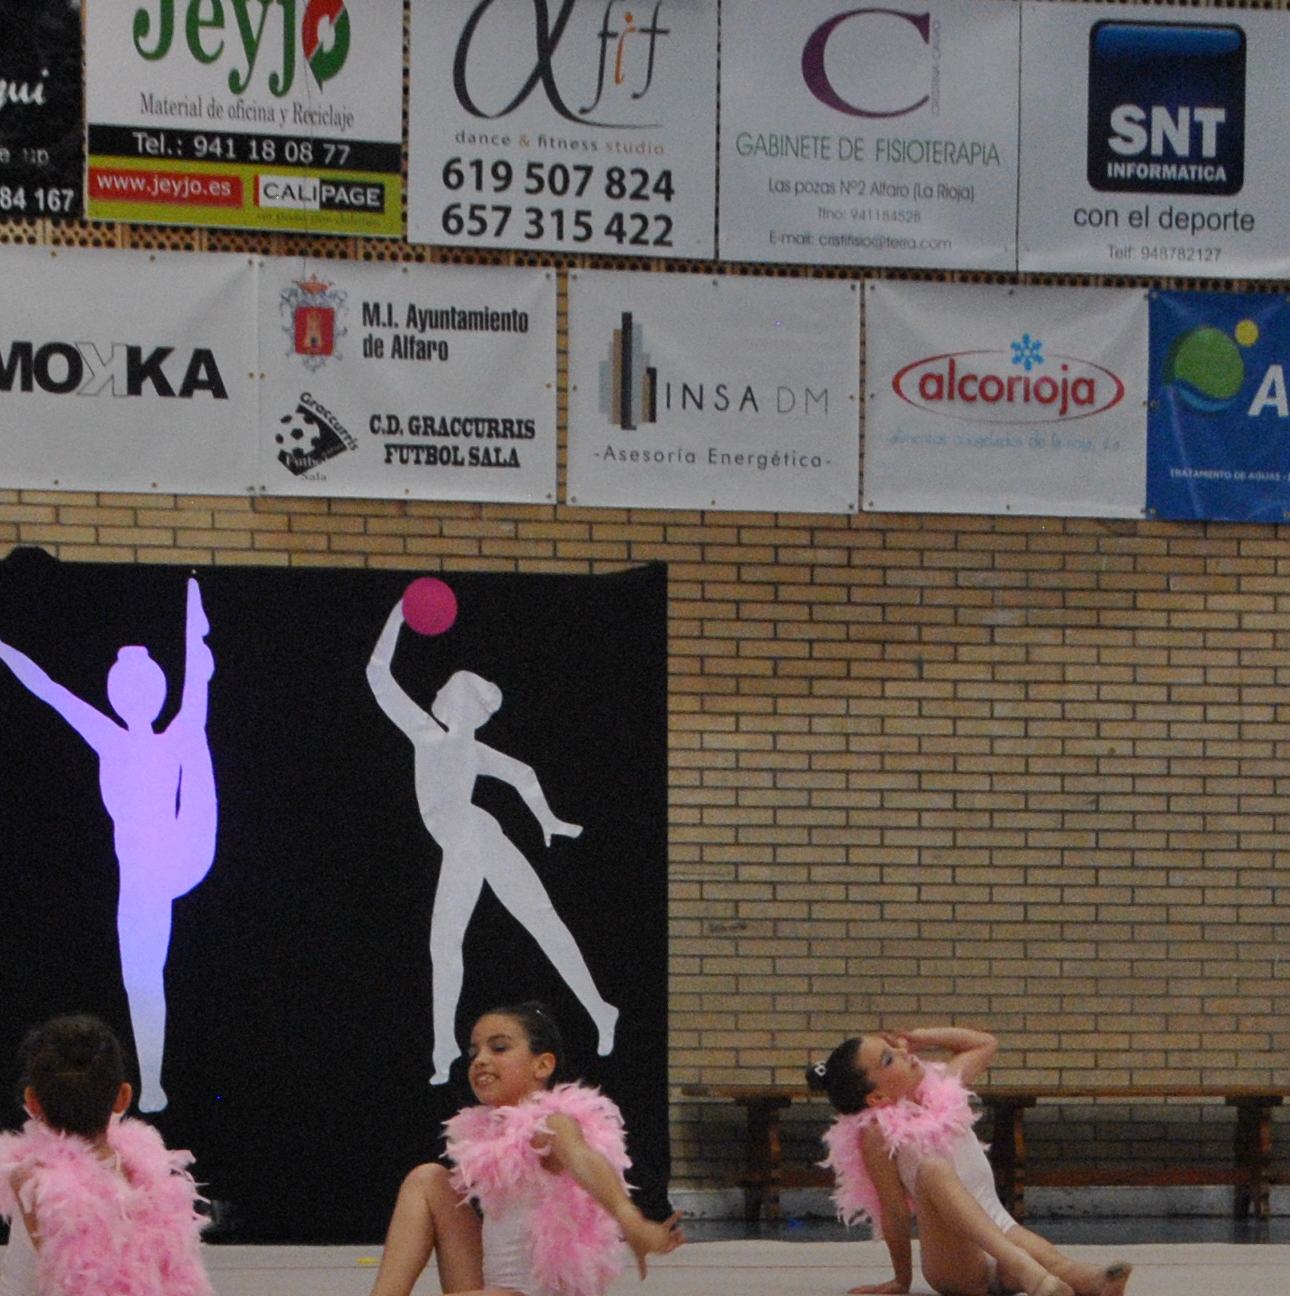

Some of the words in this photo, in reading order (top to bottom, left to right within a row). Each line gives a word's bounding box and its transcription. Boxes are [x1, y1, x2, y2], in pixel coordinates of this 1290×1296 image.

[140, 92, 203, 119] Material
[208, 95, 224, 120] de
[228, 99, 275, 123] oficina
[280, 109, 288, 127] y
[293, 102, 354, 132] Reciclaje
[457, 130, 511, 147] dance
[518, 135, 530, 148] &
[538, 134, 599, 151] fitness
[605, 139, 666, 155] studio
[1108, 103, 1226, 158] SNT
[133, 131, 183, 157] Tel.:
[193, 136, 236, 160] 941
[249, 140, 276, 162] 18
[284, 142, 314, 164] 08
[323, 144, 351, 166] 77
[736, 131, 831, 161] GABINETE
[838, 137, 864, 161] DE
[875, 138, 1000, 166] FISIOTERAPIA
[96, 172, 232, 199] www.jeyjo.es
[442, 157, 514, 193] 619
[523, 161, 594, 198] 507
[604, 165, 676, 203] 824
[1107, 161, 1228, 182] INFORMATICA
[36, 187, 76, 213] 167
[768, 176, 791, 195] Las
[794, 181, 836, 198] pozas
[869, 180, 910, 199] Alfaro
[912, 182, 934, 201] (La
[936, 183, 975, 203] Rioja)
[442, 202, 513, 239] 657
[523, 206, 594, 243] 315
[604, 211, 674, 248] 422
[1073, 206, 1119, 229] con
[1127, 204, 1150, 229] el
[1158, 206, 1256, 236] deporte
[362, 301, 399, 328] M.I.
[406, 304, 529, 334] Ayuntamiento
[362, 333, 385, 360] de
[390, 334, 449, 362] Alfaro
[665, 382, 759, 413] INSA
[776, 385, 829, 416] DM
[919, 357, 1096, 417] alcorioja
[299, 391, 360, 452] Graccurris
[369, 413, 404, 437] C.D.
[408, 416, 536, 440] GRACCURRIS
[384, 443, 465, 467] FUTBOL
[468, 446, 521, 469] SALA
